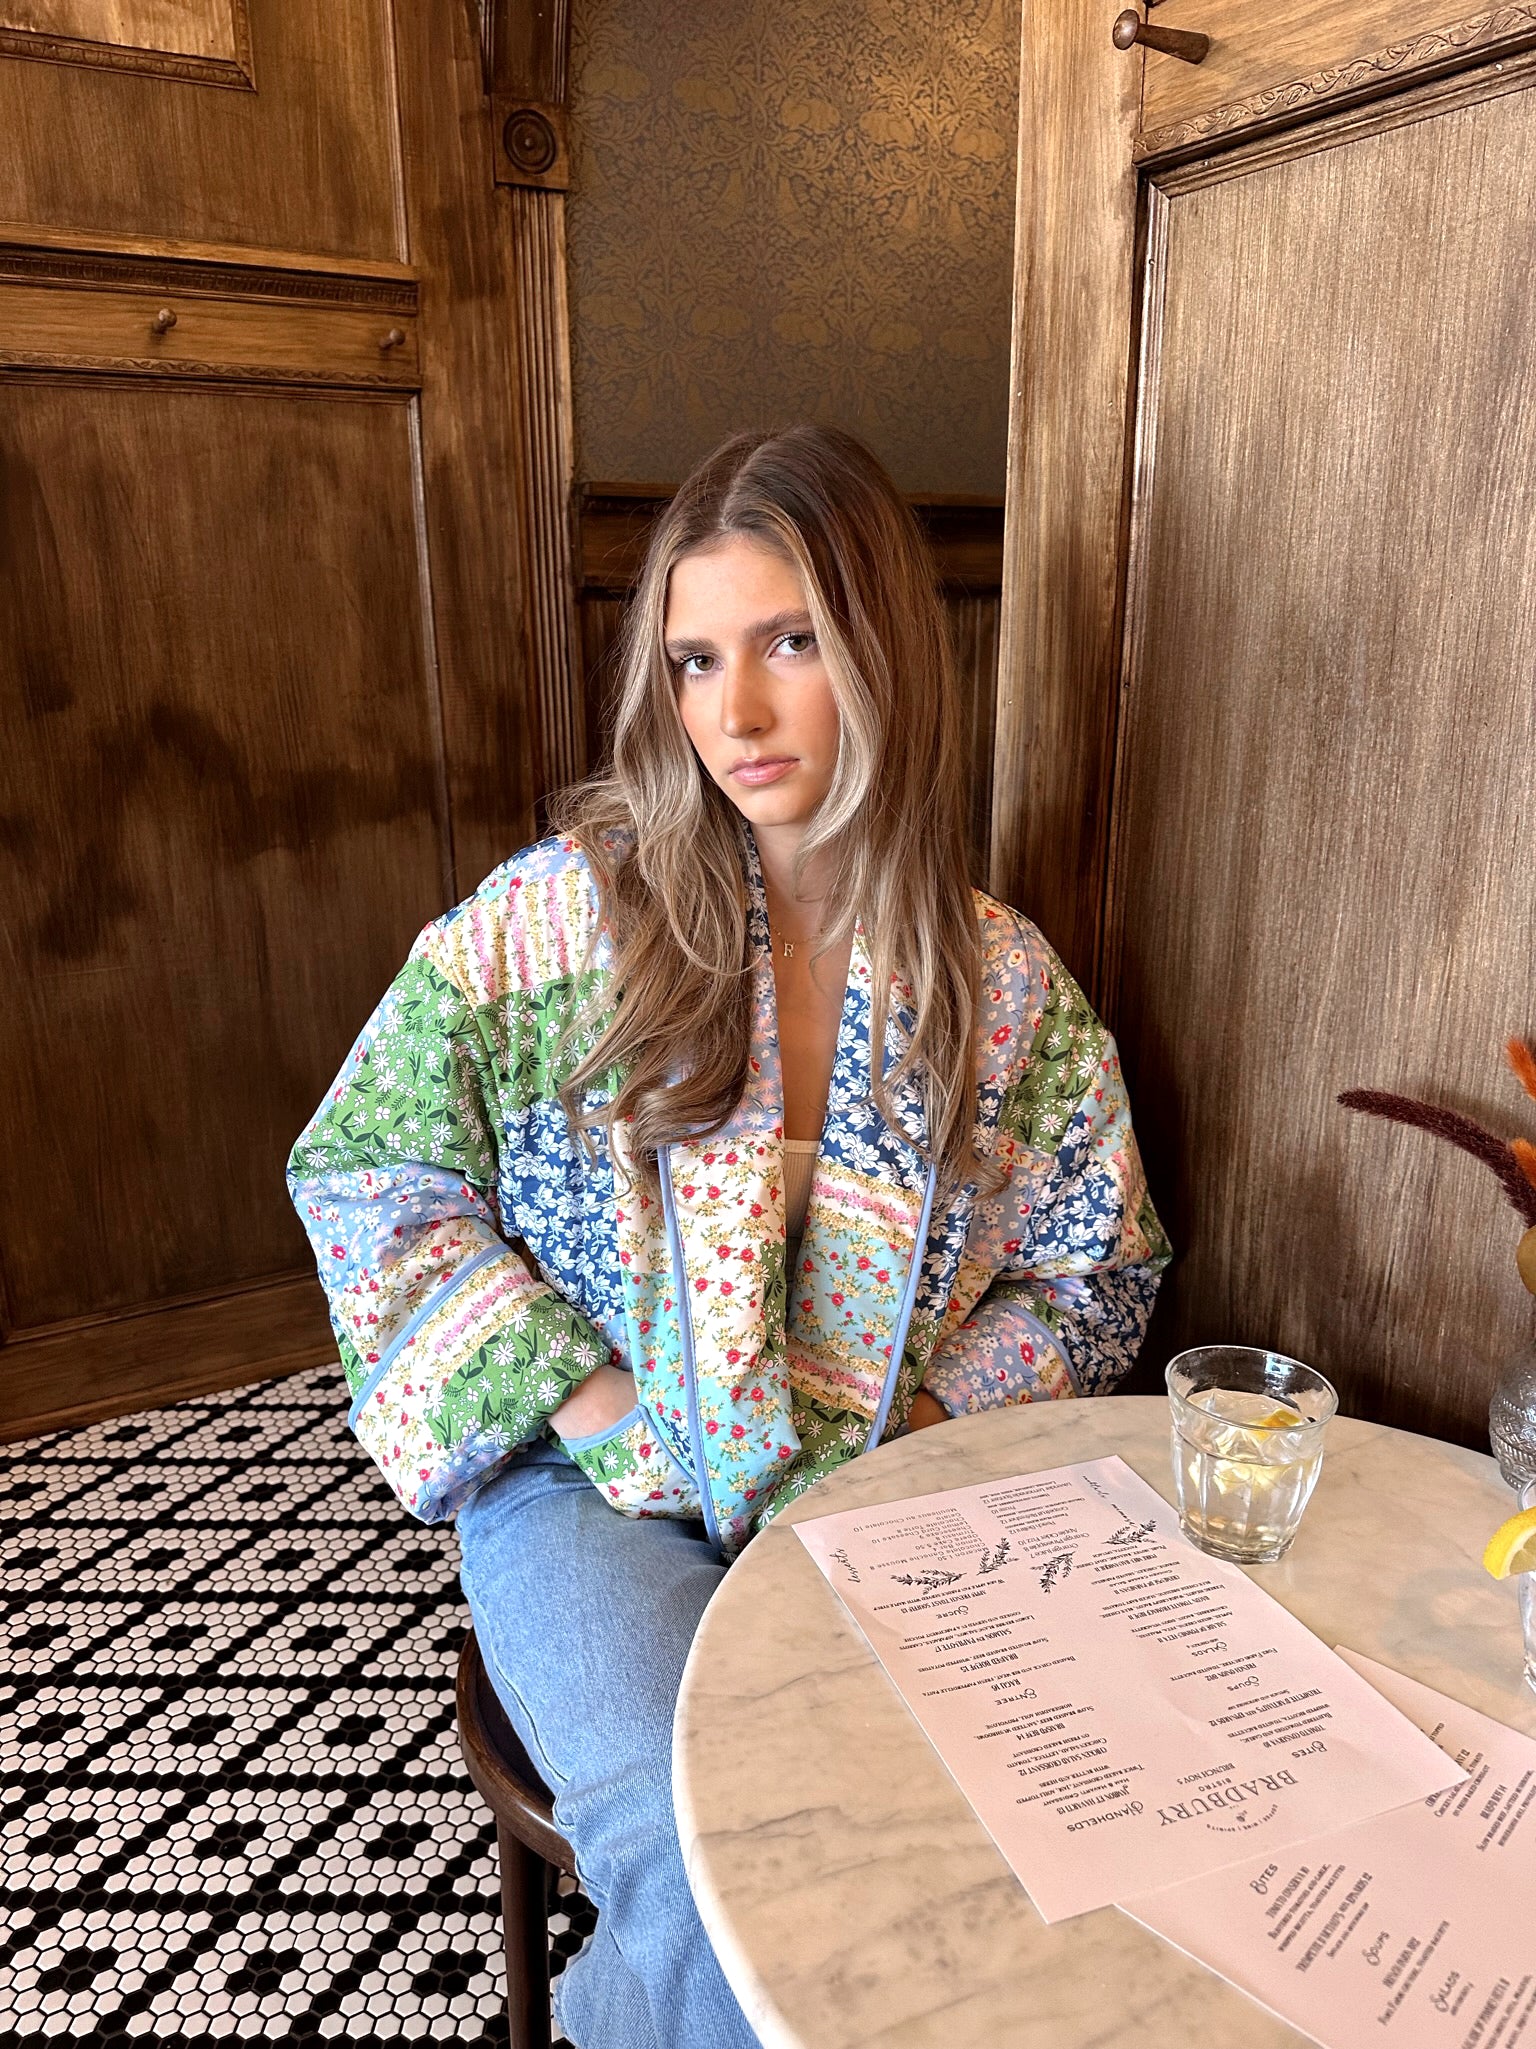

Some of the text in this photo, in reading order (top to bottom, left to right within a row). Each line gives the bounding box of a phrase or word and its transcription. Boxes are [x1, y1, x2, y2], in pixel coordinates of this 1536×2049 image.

[783, 943, 794, 957] R
[936, 1605, 969, 1619] SUCRE
[984, 1629, 1012, 1639] SALMON
[1191, 1642, 1227, 1657] SALADS
[999, 1678, 1021, 1689] RAGU
[1227, 1676, 1260, 1691] SOUPS
[994, 1688, 1037, 1705] ENTREE
[1299, 1724, 1326, 1737] TOMATO
[1043, 1741, 1062, 1749] BAKED
[1079, 1738, 1107, 1748] CHICKEN
[1269, 1732, 1301, 1746] CONSERVA
[1081, 1747, 1107, 1758] CHICKEN
[1291, 1741, 1327, 1758] BITES
[1006, 1758, 1032, 1768] TOMATO
[1061, 1753, 1082, 1764] SALAD
[1027, 1760, 1062, 1774] CROISSANT
[1123, 1764, 1144, 1773] TWICE
[1200, 1763, 1235, 1777] BRUNCH
[1103, 1770, 1123, 1779] BAKED
[1184, 1773, 1202, 1783] NOV
[1080, 1784, 1107, 1795] HAVARTI
[1198, 1778, 1232, 1792] BISTRO
[1016, 1794, 1040, 1804] TOPPED
[1043, 1793, 1079, 1806] CROISSANT
[1104, 1785, 1130, 1800] JAMBON
[1156, 1769, 1298, 1826] BRADBURY
[1064, 1798, 1096, 1812] HAVARTI
[1067, 1801, 1143, 1832] HANDHELDS
[1249, 1863, 1278, 1895] BITES
